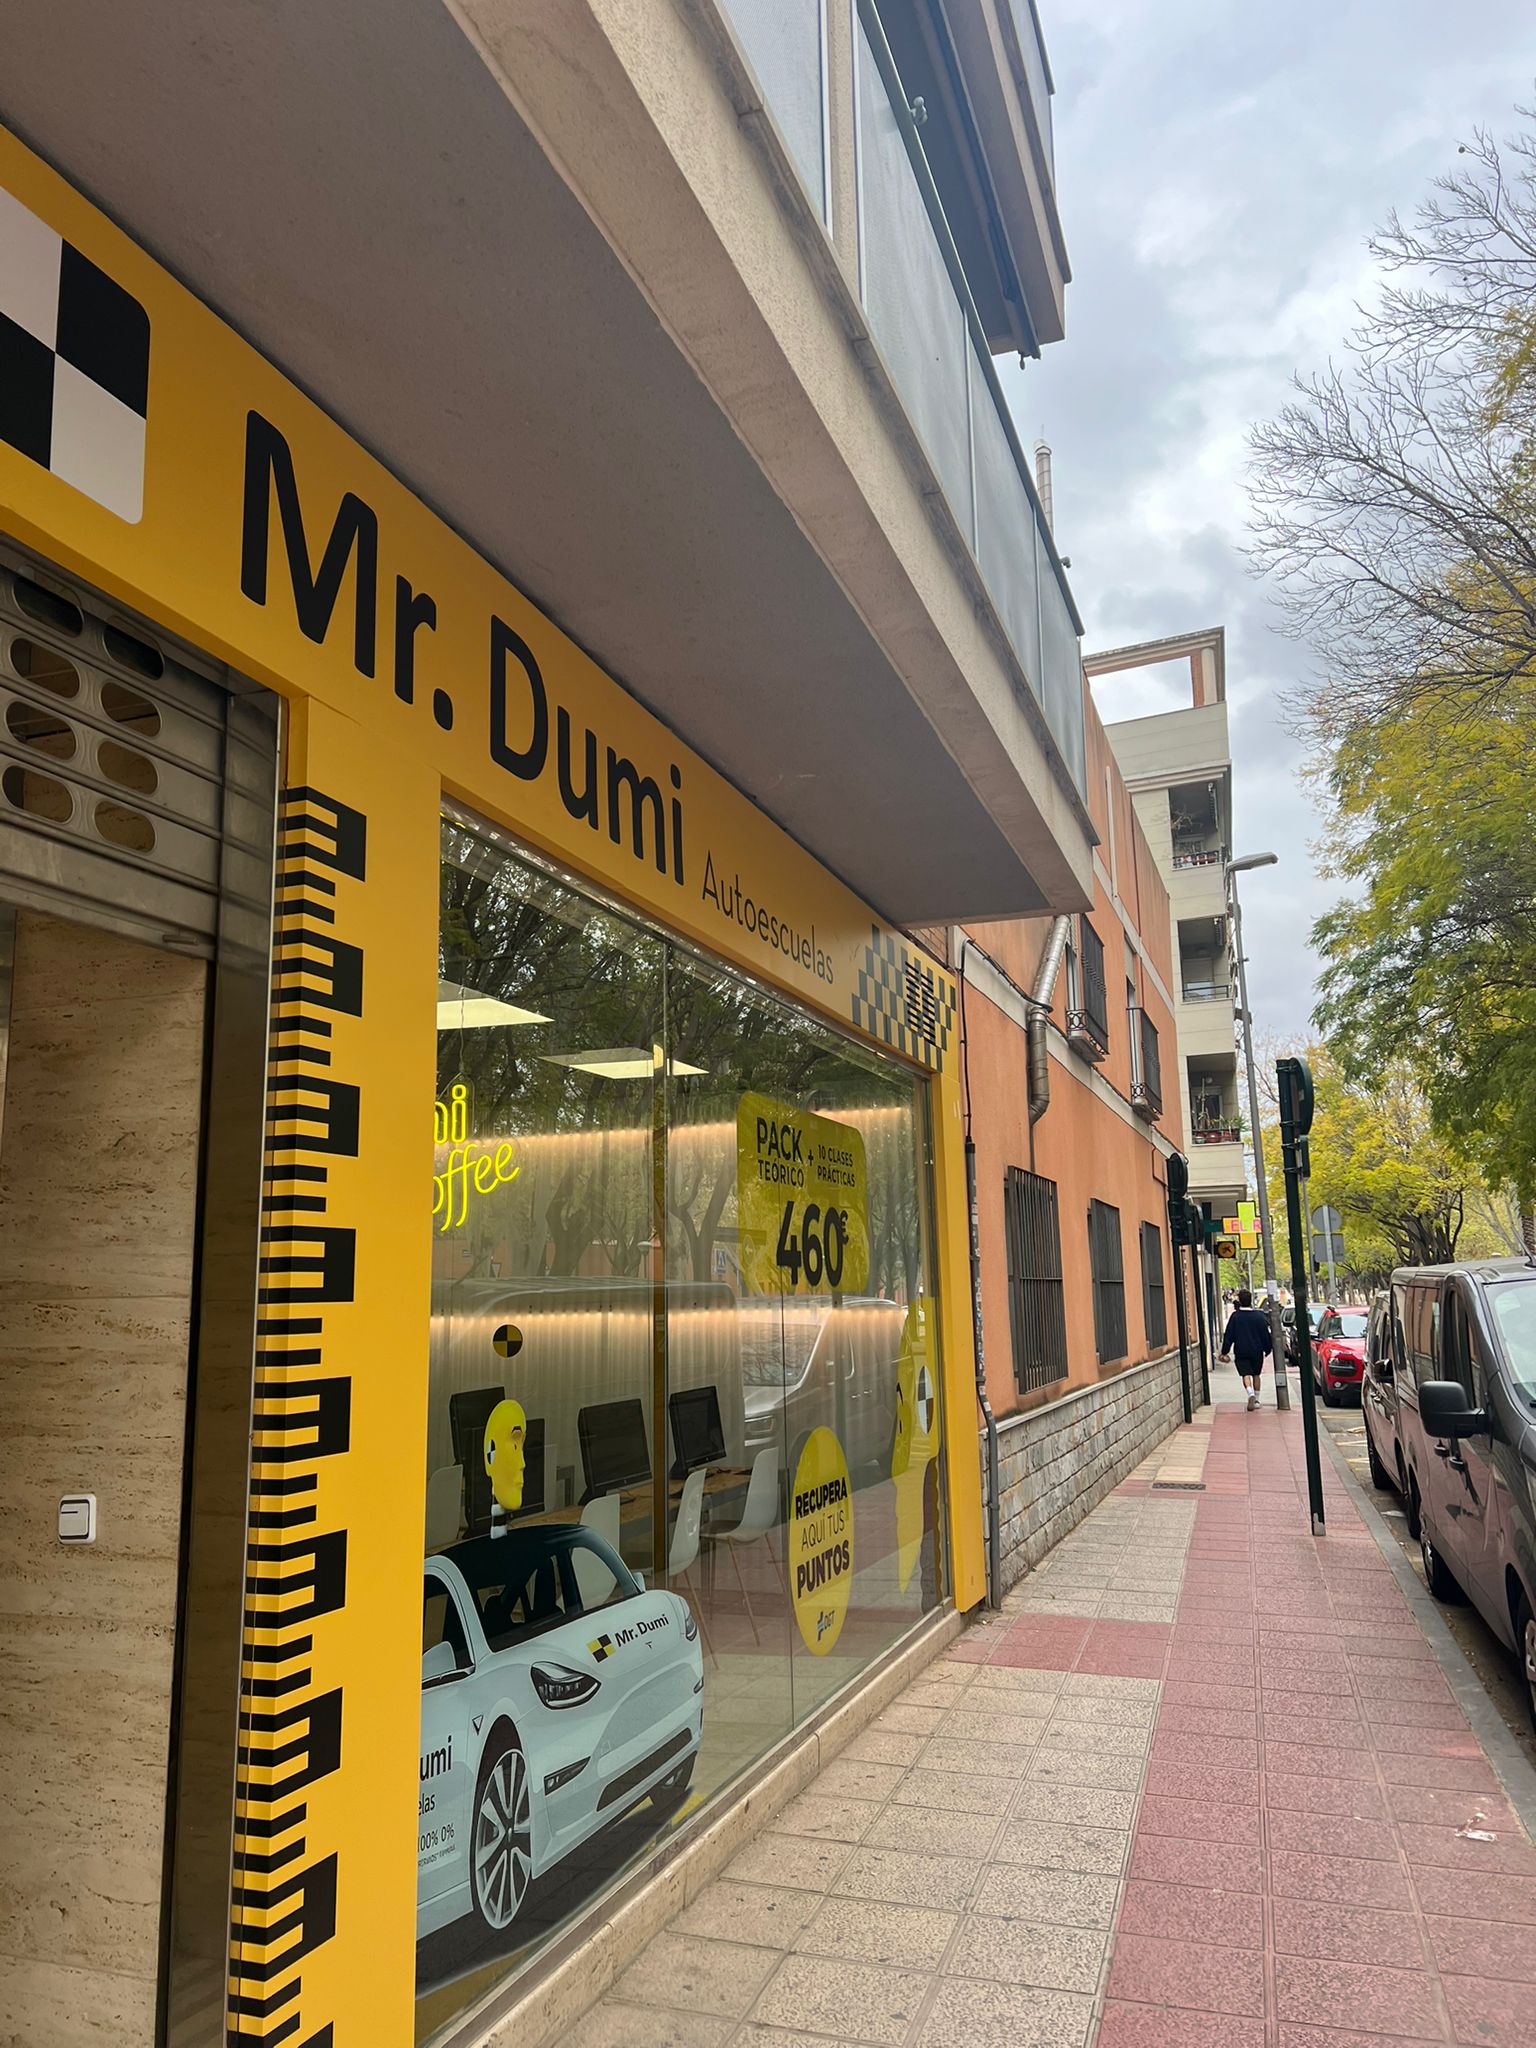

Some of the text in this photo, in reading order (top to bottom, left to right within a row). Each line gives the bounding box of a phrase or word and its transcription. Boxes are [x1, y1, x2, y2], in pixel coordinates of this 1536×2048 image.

[240, 409, 685, 887] Mr. Dumi
[702, 849, 834, 985] Autoescuelas
[756, 1116, 803, 1165] PACK
[817, 1144, 853, 1168] 10 CLASES
[757, 1158, 805, 1188] TEÓRICO
[817, 1164, 856, 1188] PRÁCTICAS
[1230, 1219, 1247, 1232] EL
[795, 1476, 848, 1521] RECUPERA
[801, 1509, 845, 1552] AQUÍ TUS
[796, 1539, 850, 1599] PUNTOS
[614, 1613, 670, 1648] Mr. Dumi
[440, 1822, 455, 1842] 0%
